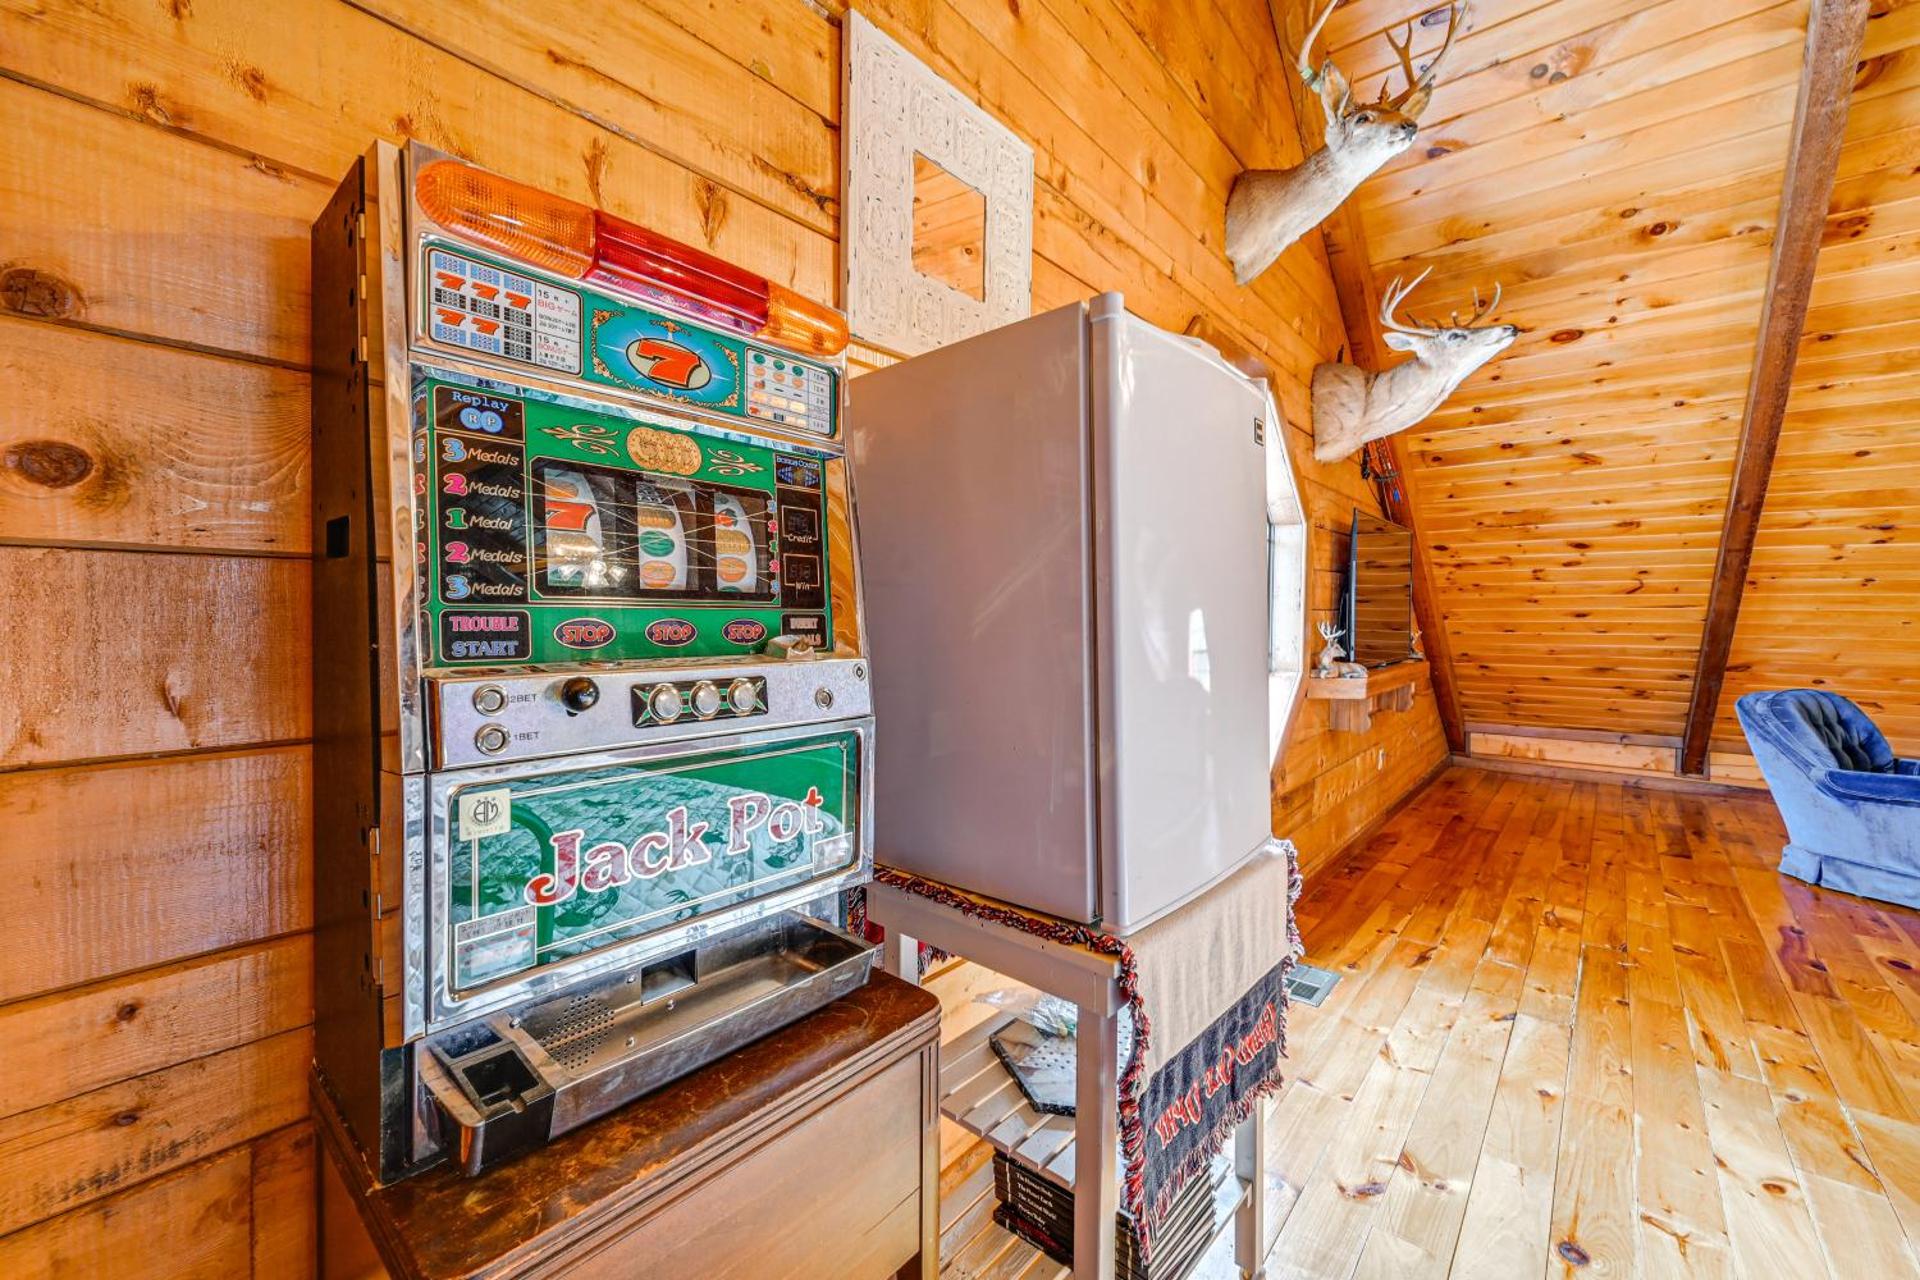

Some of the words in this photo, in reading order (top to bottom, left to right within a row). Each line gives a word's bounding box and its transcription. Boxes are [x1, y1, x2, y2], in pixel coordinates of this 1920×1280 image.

[636, 338, 701, 388] 7
[451, 391, 508, 412] Replay
[442, 438, 467, 462] 3
[467, 448, 519, 466] Medals
[443, 472, 468, 497] 2
[469, 481, 521, 499] Medals
[446, 508, 468, 529] 1
[469, 514, 512, 530] Medal
[445, 542, 470, 564] 2
[470, 548, 522, 564] Medals
[446, 575, 471, 599] 3
[471, 582, 524, 597] Medals
[449, 616, 518, 632] TROUBLE
[562, 625, 609, 642] STOP
[652, 625, 691, 641] STOP
[727, 624, 762, 641] STOP
[452, 640, 518, 657] START
[510, 694, 537, 703] 2BET
[513, 732, 539, 741] 1BET
[525, 806, 712, 906] Jack
[728, 786, 823, 856] Pot
